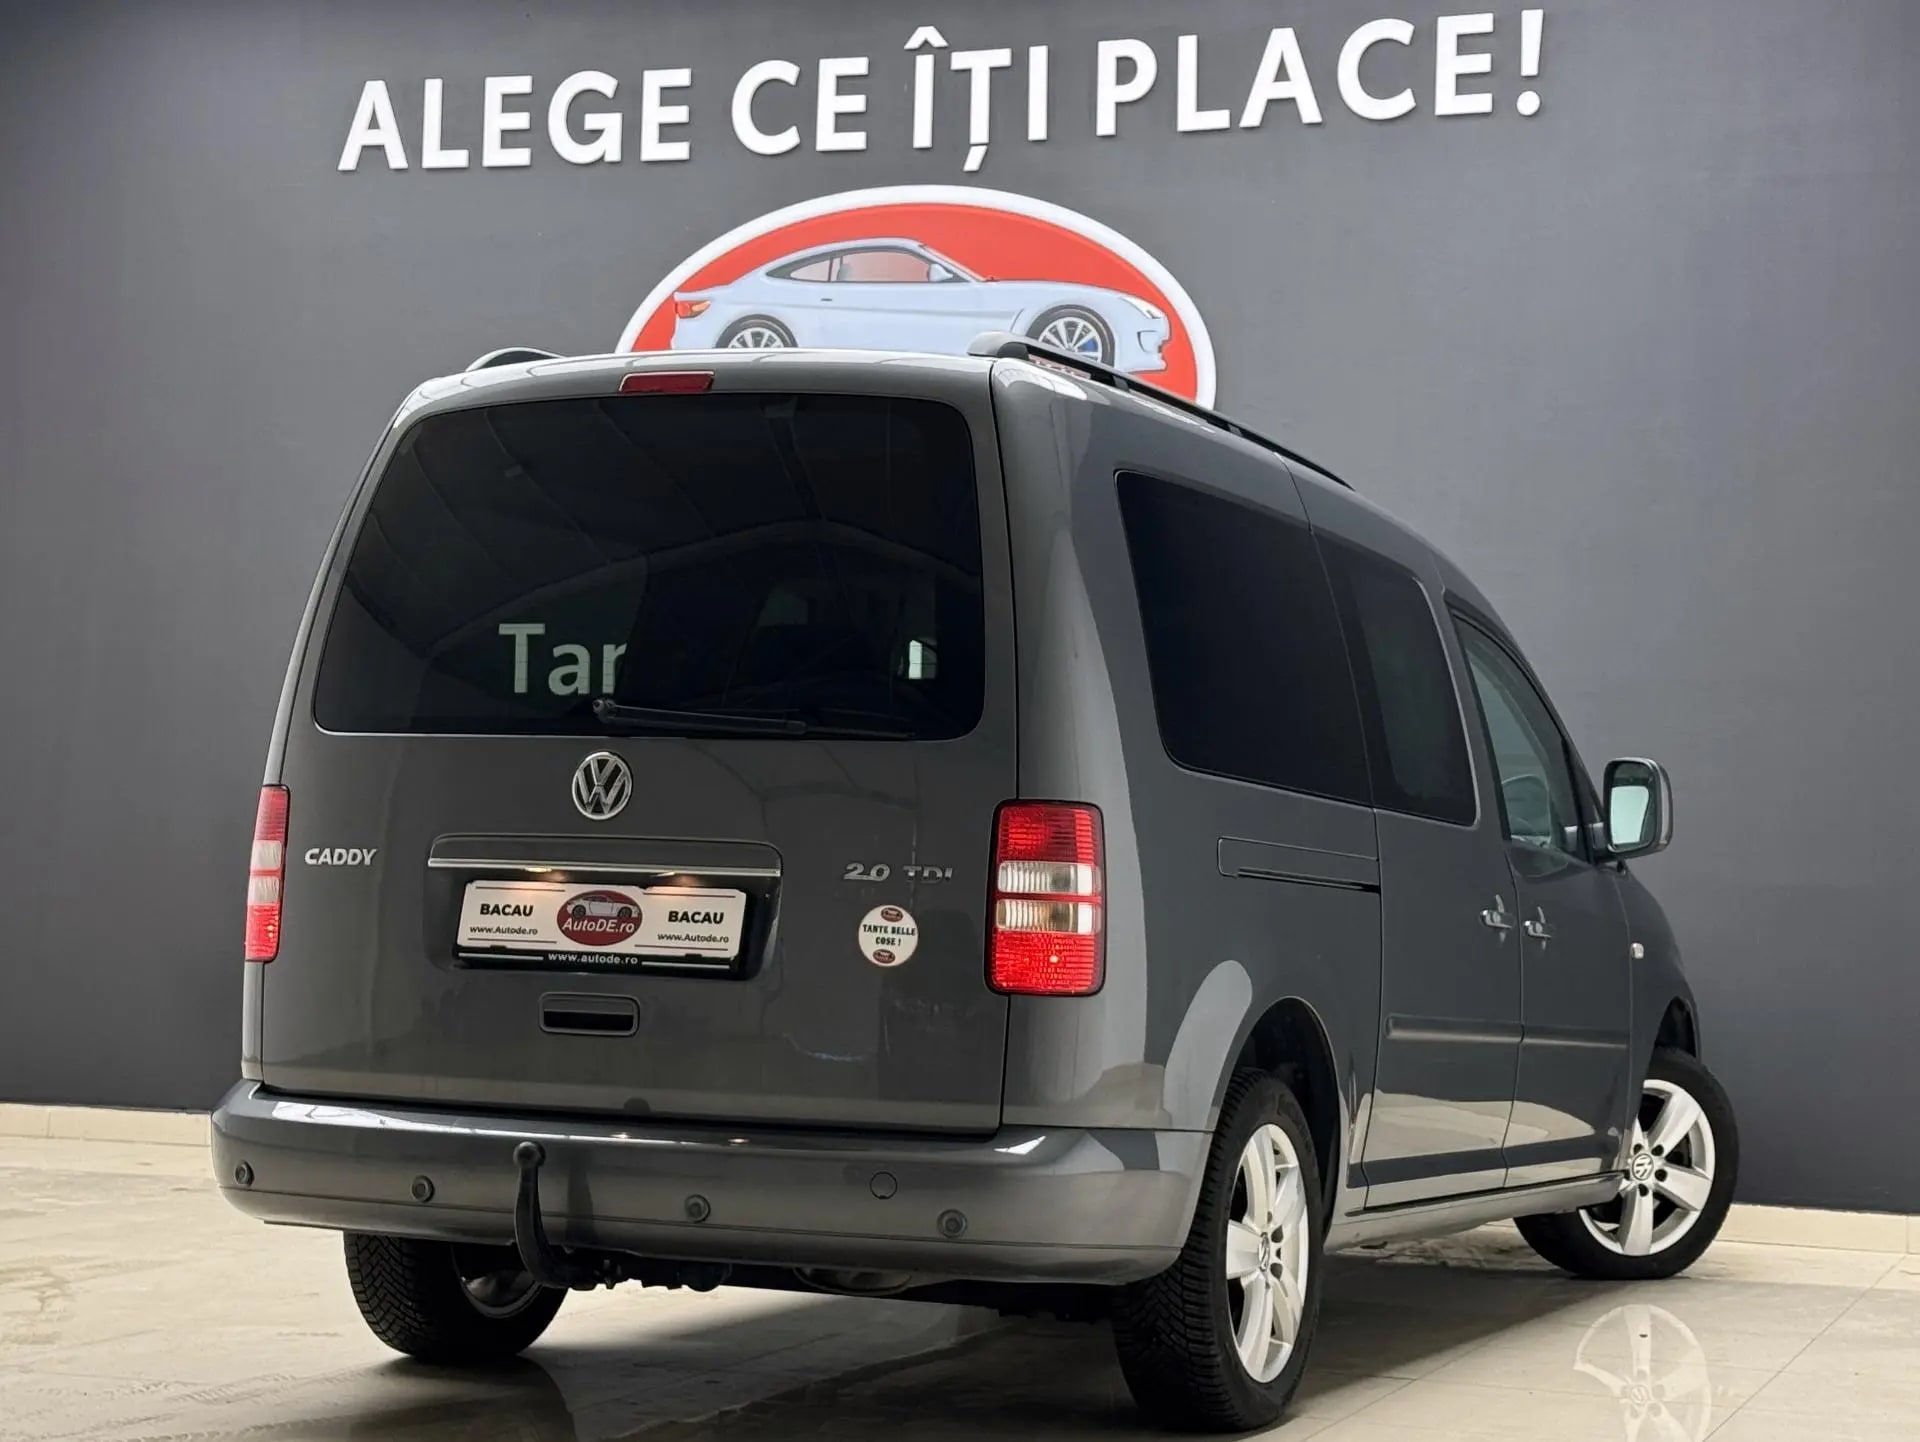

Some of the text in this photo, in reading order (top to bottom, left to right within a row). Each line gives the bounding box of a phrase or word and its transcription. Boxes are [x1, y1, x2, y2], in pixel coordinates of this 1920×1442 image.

[338, 69, 692, 170] ALEGE
[731, 57, 869, 155] CE
[1096, 9, 1544, 136] PLACE!
[304, 848, 377, 866] CADDY
[903, 865, 953, 884] TDI
[480, 903, 533, 917] BACAU
[668, 911, 724, 925] BACAU
[470, 925, 538, 936] www.Autode.ro
[562, 917, 636, 934] AutoDE.ro
[863, 924, 916, 936] TANTE BELLE
[657, 933, 729, 944] www.Autode.ro
[876, 937, 895, 946] COSE
[548, 952, 638, 966] www.autode.ro
